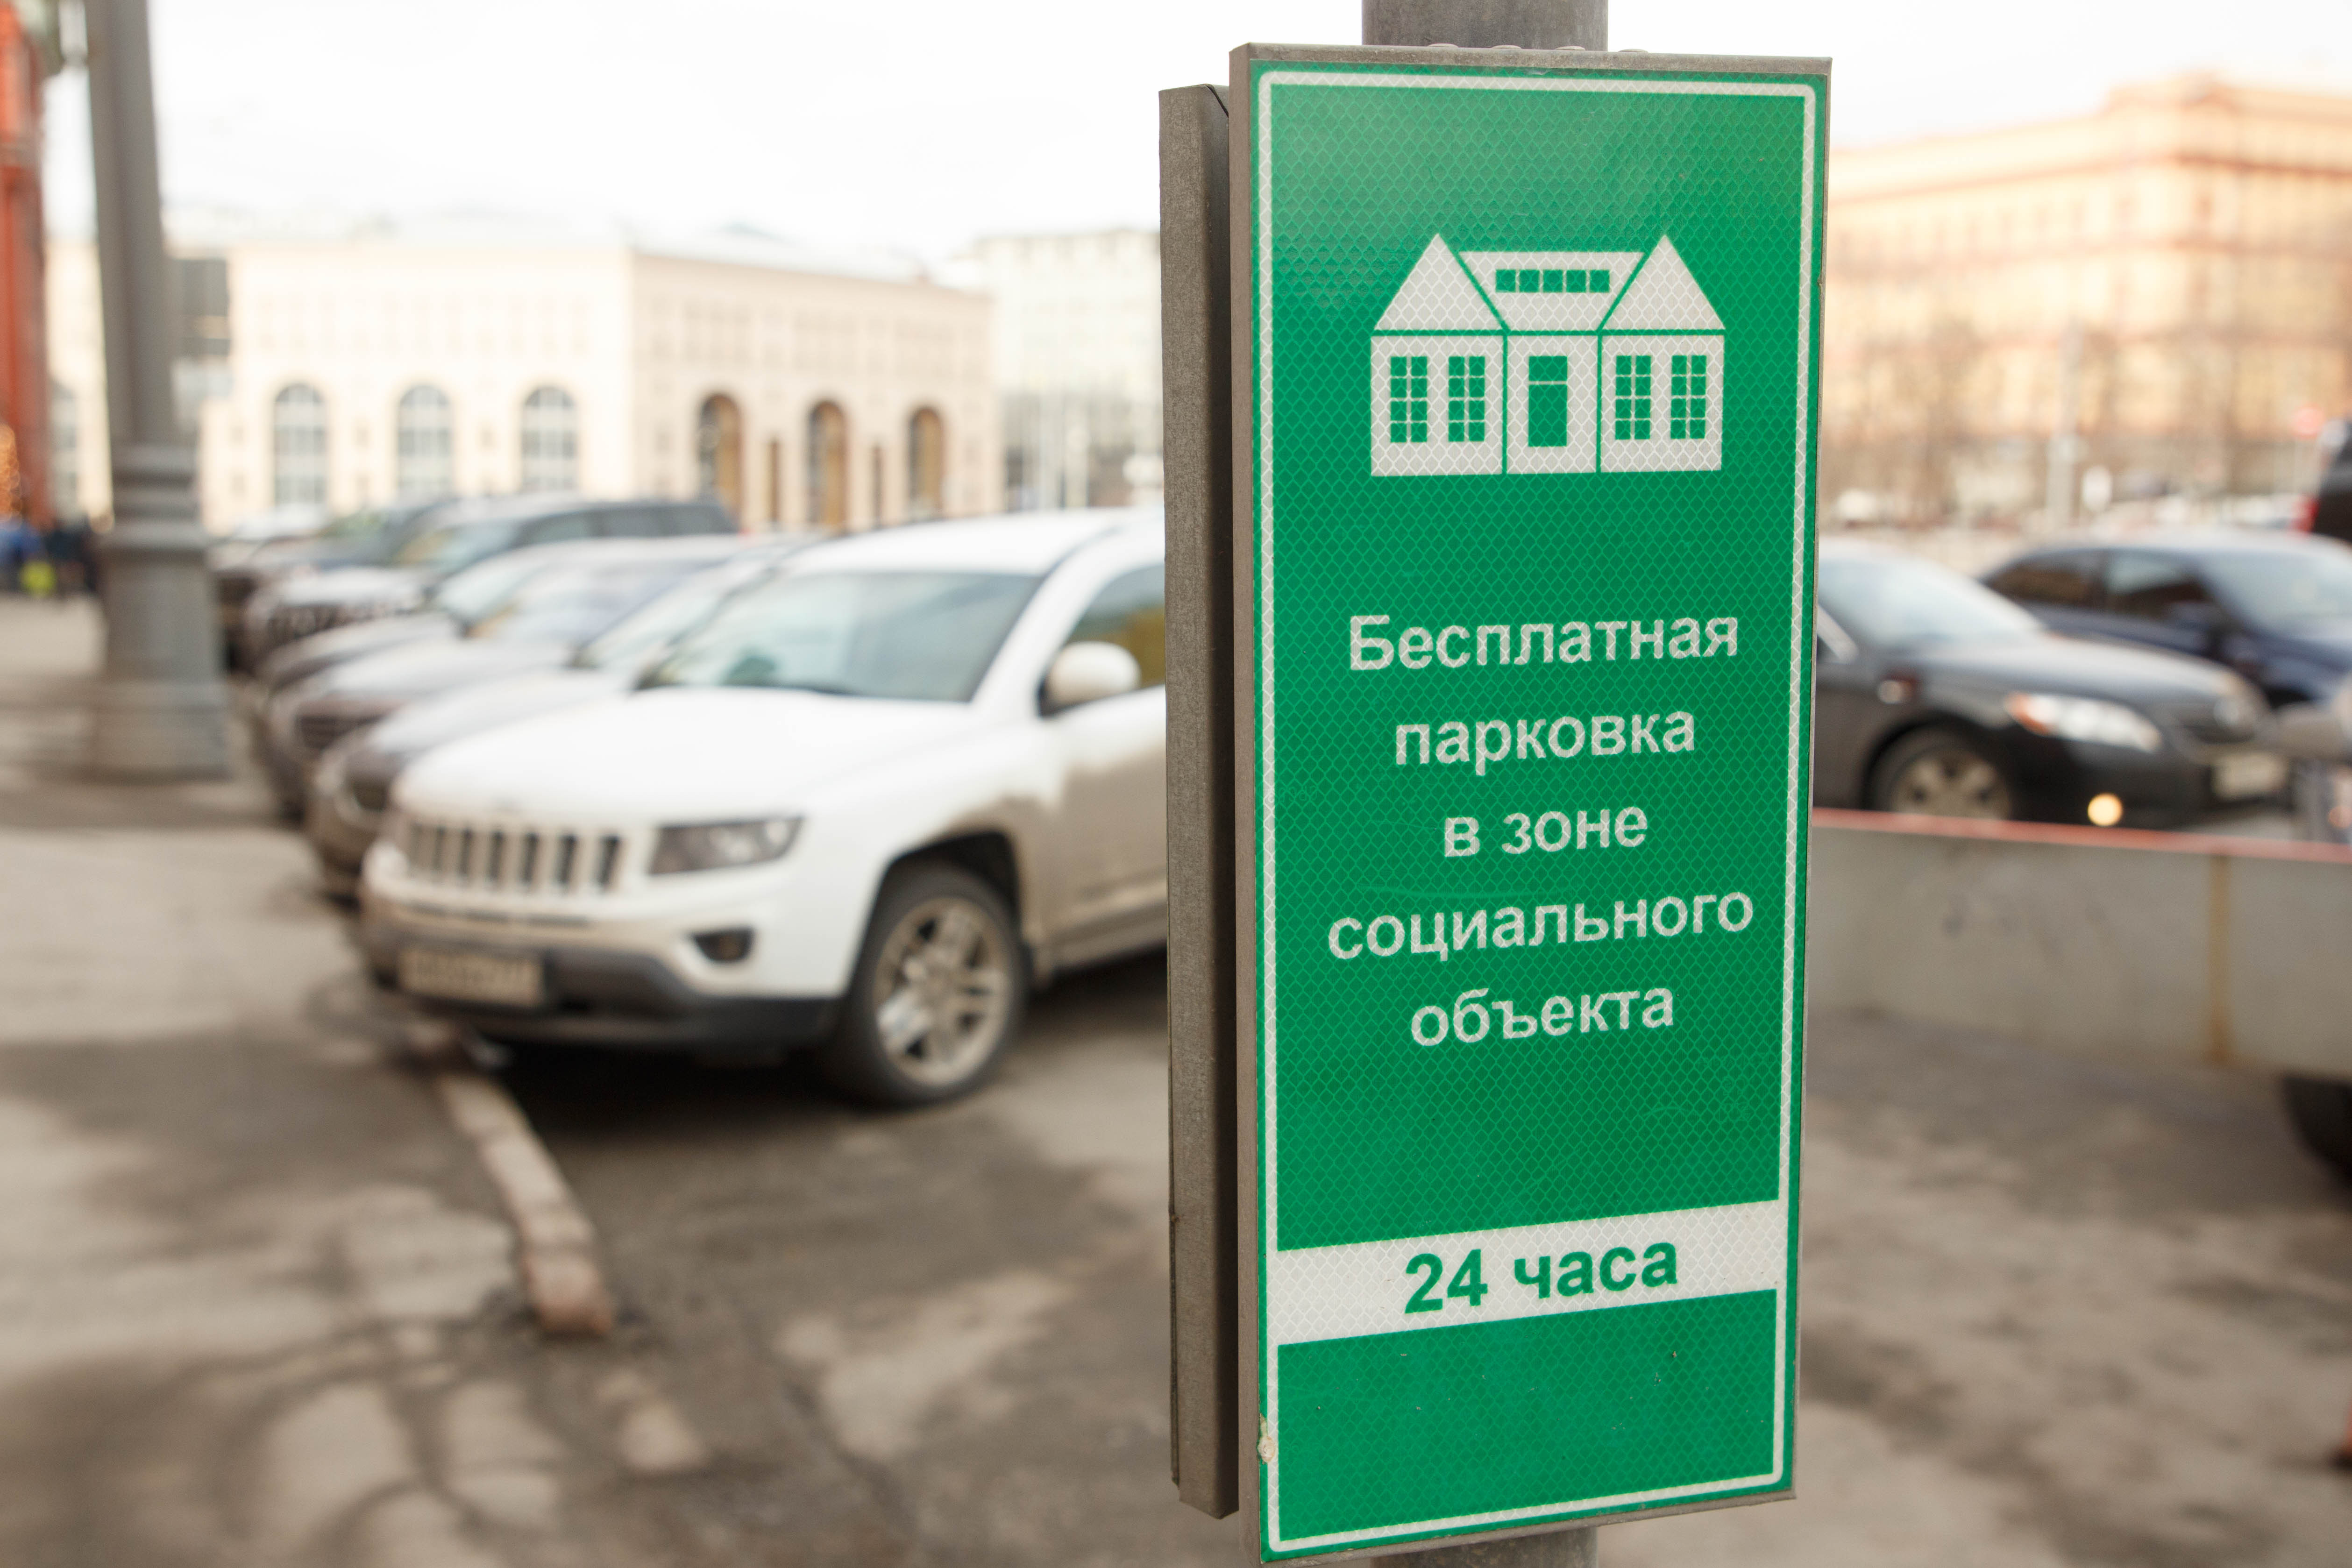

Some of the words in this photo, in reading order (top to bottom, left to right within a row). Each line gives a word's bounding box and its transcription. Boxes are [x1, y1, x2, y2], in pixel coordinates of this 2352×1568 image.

[1350, 614, 1738, 671] Бесплатная
[1395, 710, 1695, 776] парковка
[1444, 816, 1480, 858] в
[1501, 806, 1648, 855] зоне
[1328, 891, 1754, 962] социального
[1410, 987, 1674, 1047] объекта
[1404, 1249, 1488, 1314] 24
[1514, 1242, 1677, 1299] часа
